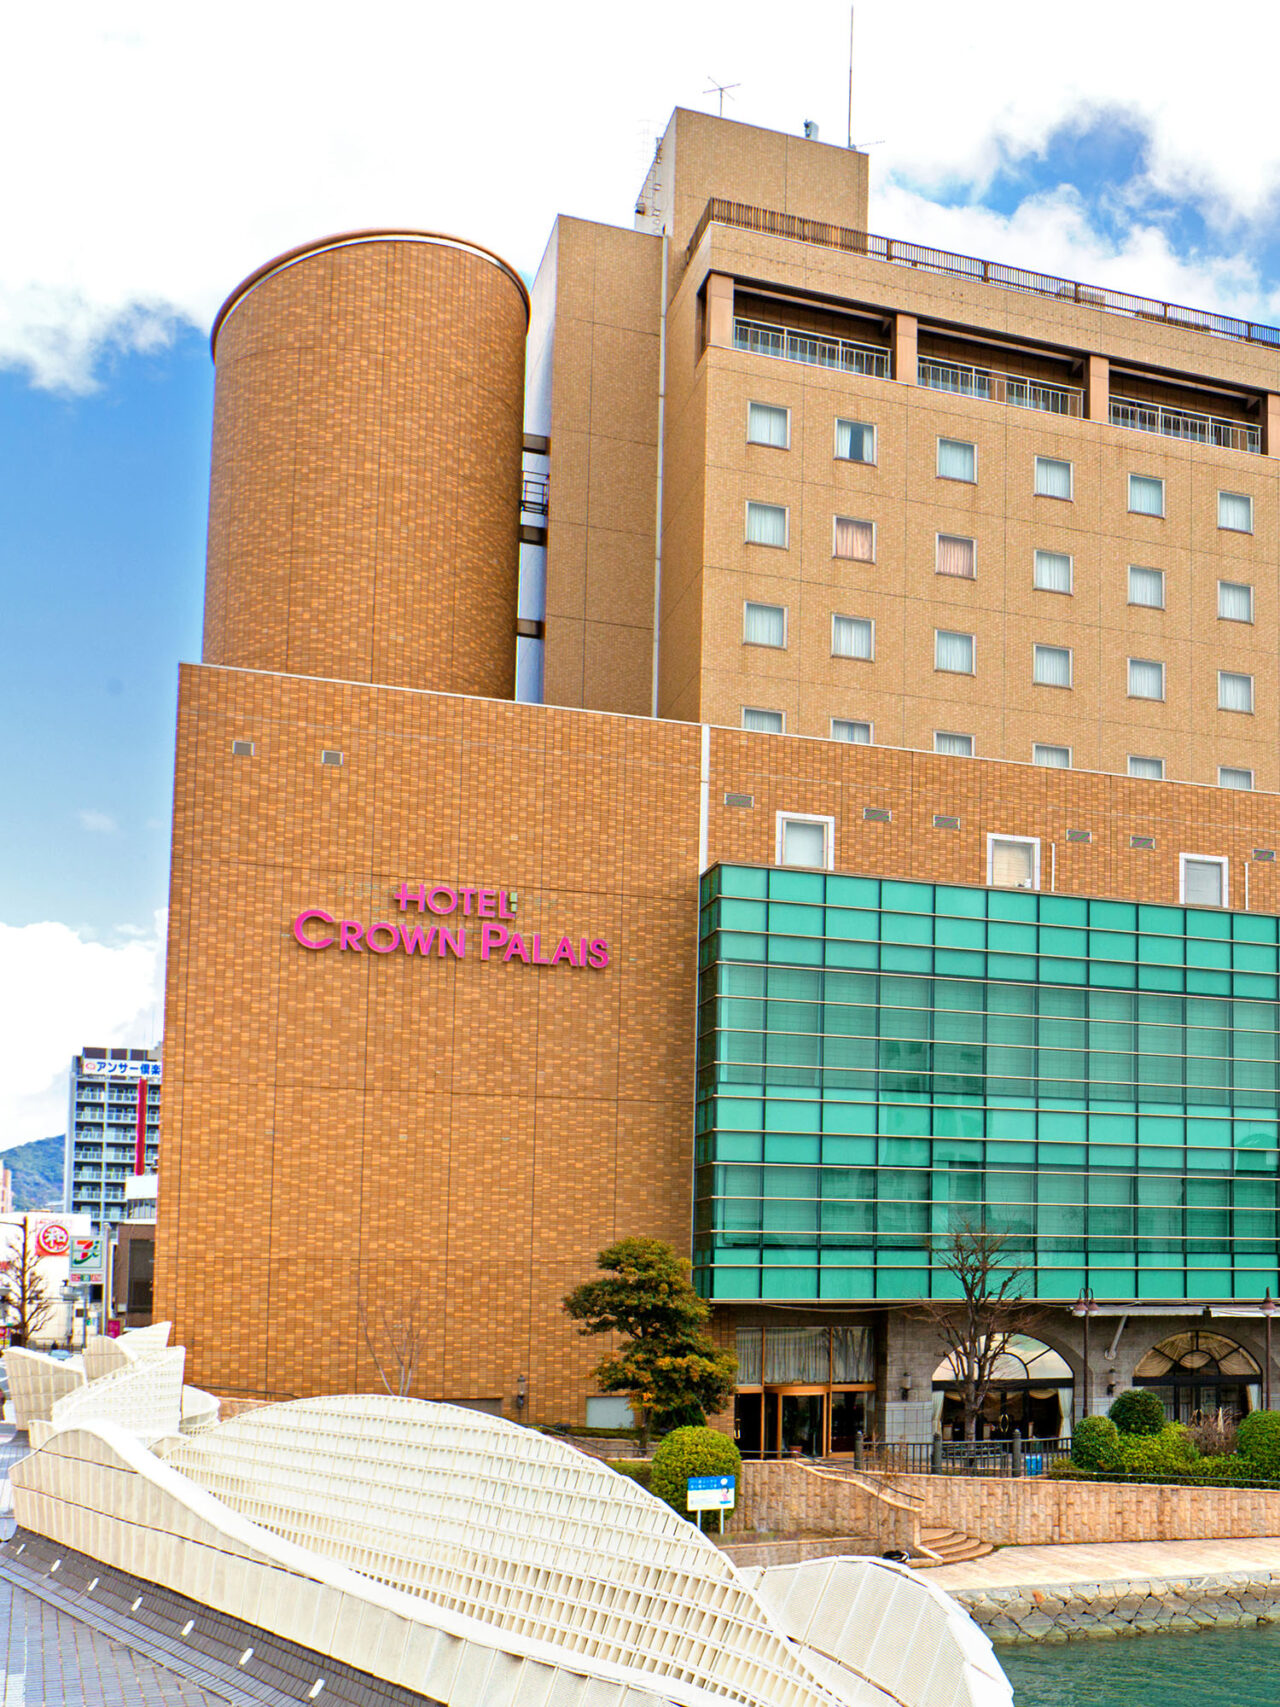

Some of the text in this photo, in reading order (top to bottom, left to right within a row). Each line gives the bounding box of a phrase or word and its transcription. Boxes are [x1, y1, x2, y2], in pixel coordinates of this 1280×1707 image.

[394, 883, 515, 919] HOTEL
[294, 909, 610, 969] CROWN PALAIS
